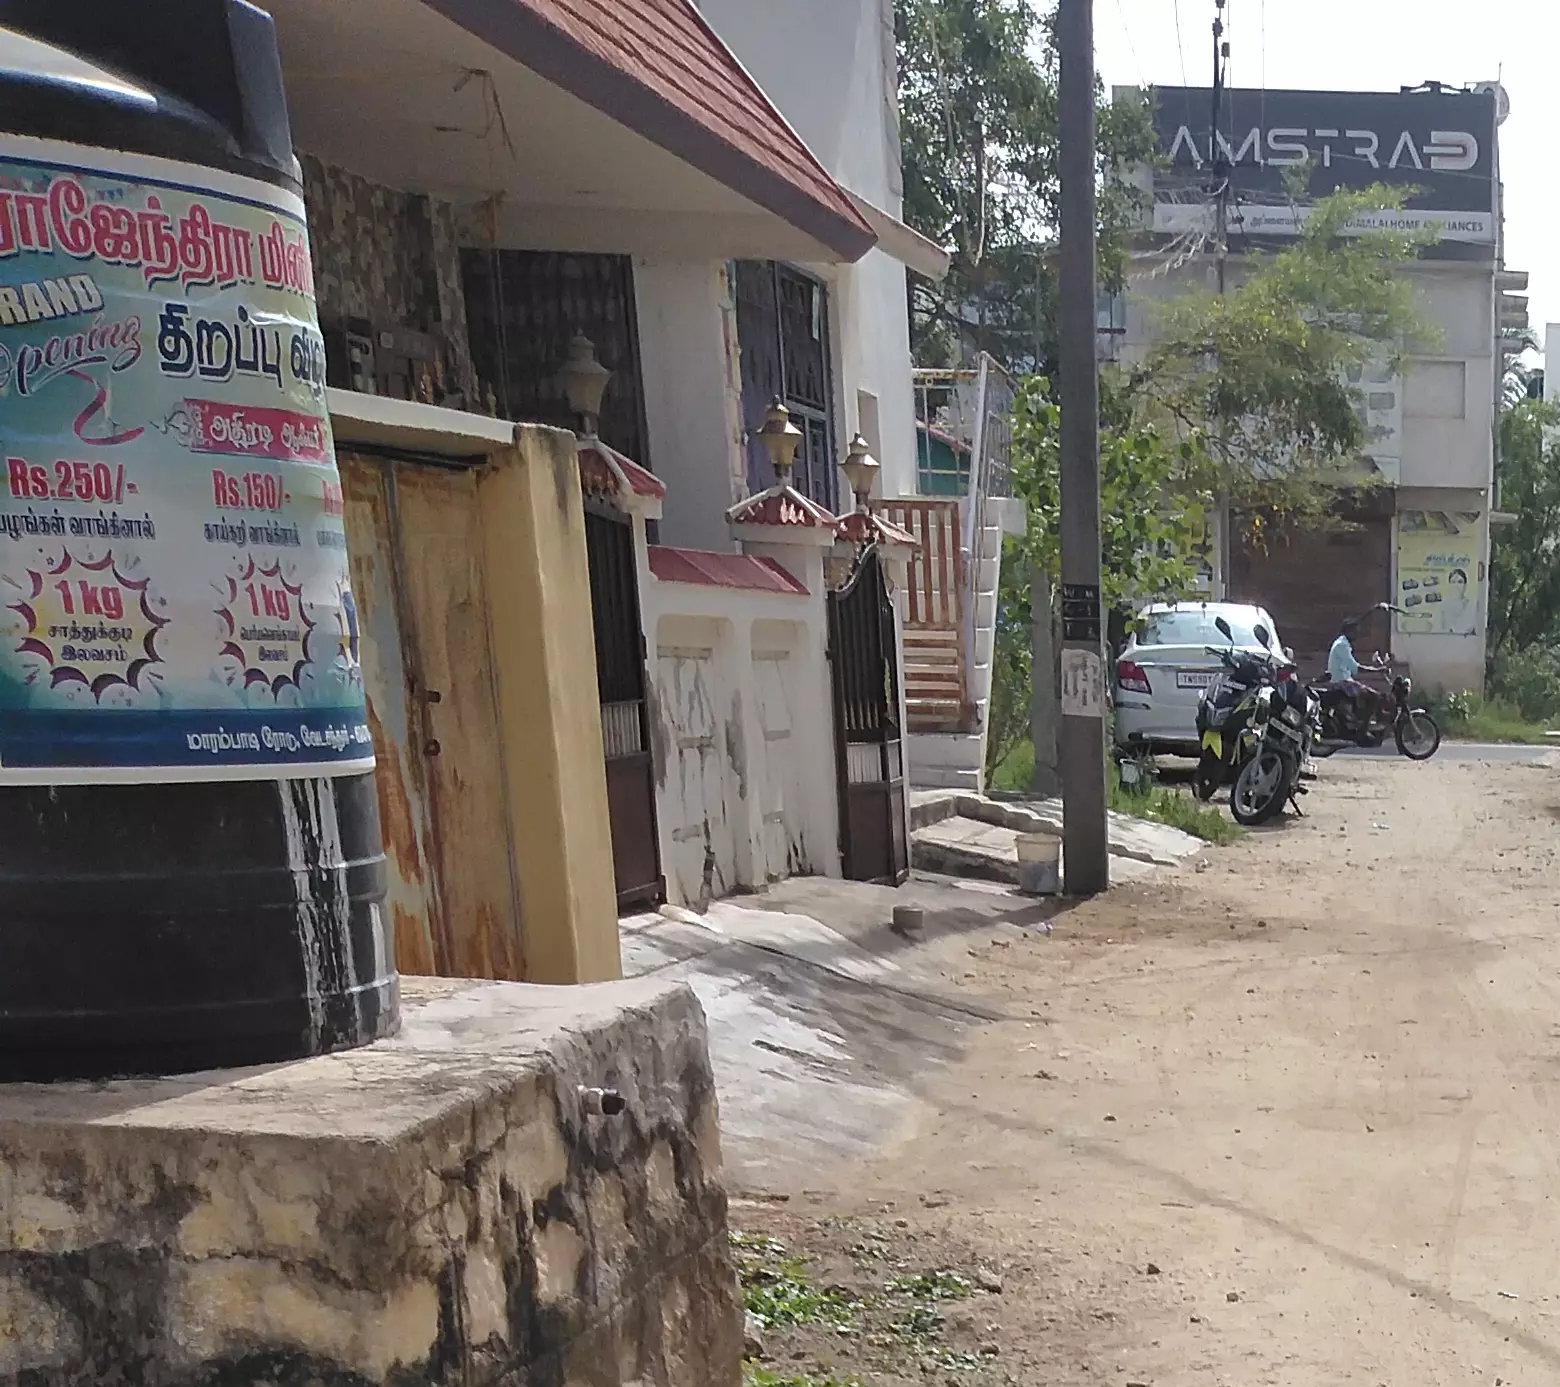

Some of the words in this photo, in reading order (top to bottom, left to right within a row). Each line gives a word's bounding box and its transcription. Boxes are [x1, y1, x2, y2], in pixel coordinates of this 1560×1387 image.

[1169, 126, 1479, 170] AMSTRAD
[1423, 220, 1484, 232] AIANCES
[157, 302, 283, 389] திறப்பு
[210, 411, 273, 451] அதிரடி
[7, 457, 139, 503] Rs.250/-
[212, 469, 291, 510] Rs.150/-
[70, 509, 156, 540] வாங்கினால்
[204, 516, 246, 548] காய்கறி
[54, 579, 75, 615] 1
[79, 580, 124, 620] kg
[244, 582, 259, 617] 1
[260, 583, 290, 621] kg
[47, 620, 133, 643] சாத்துக்குடி
[61, 644, 128, 662] இலவசம்
[187, 726, 260, 753] மாரம்பாடி
